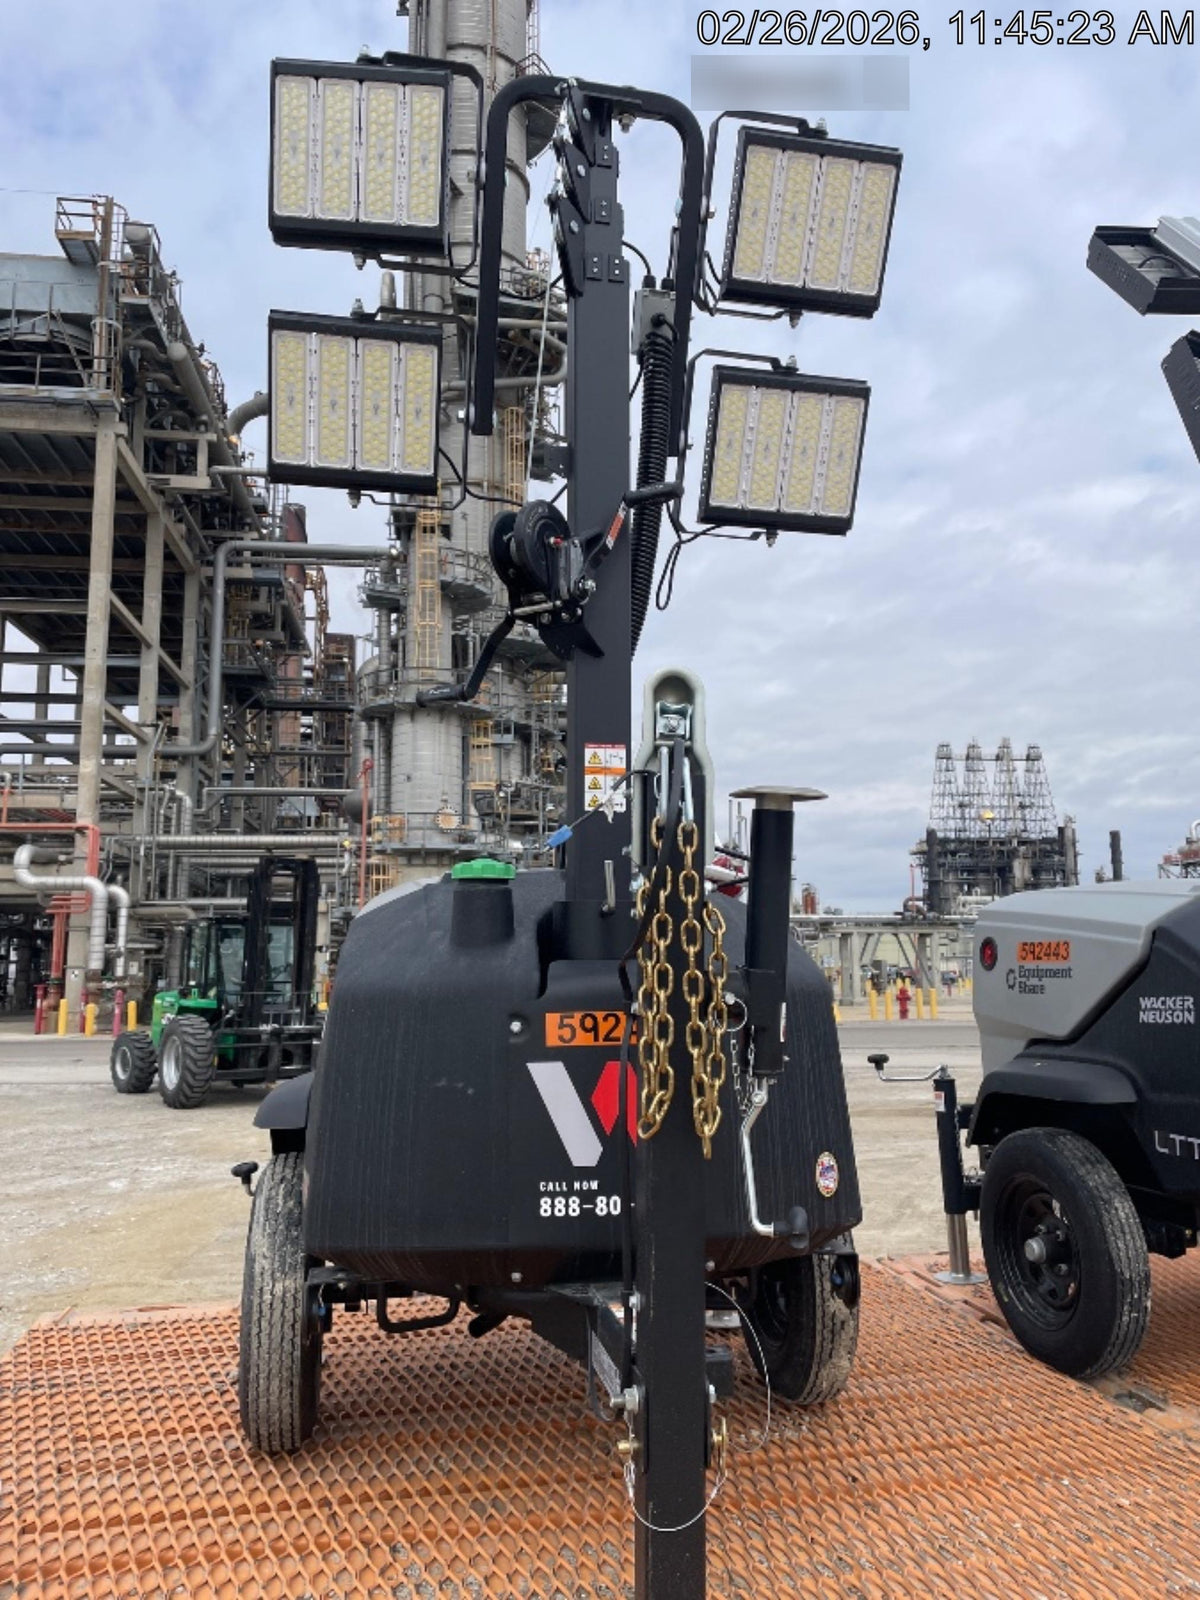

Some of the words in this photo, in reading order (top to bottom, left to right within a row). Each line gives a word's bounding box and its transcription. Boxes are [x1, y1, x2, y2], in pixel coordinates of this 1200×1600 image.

[1020, 941, 1070, 961] 592443
[1018, 965, 1073, 982] Equipment
[1018, 981, 1046, 995] Share
[1139, 996, 1194, 1009] WACKER
[1139, 1010, 1195, 1024] NEUSON
[540, 1181, 568, 1192] CALL
[573, 1180, 599, 1191] NOW
